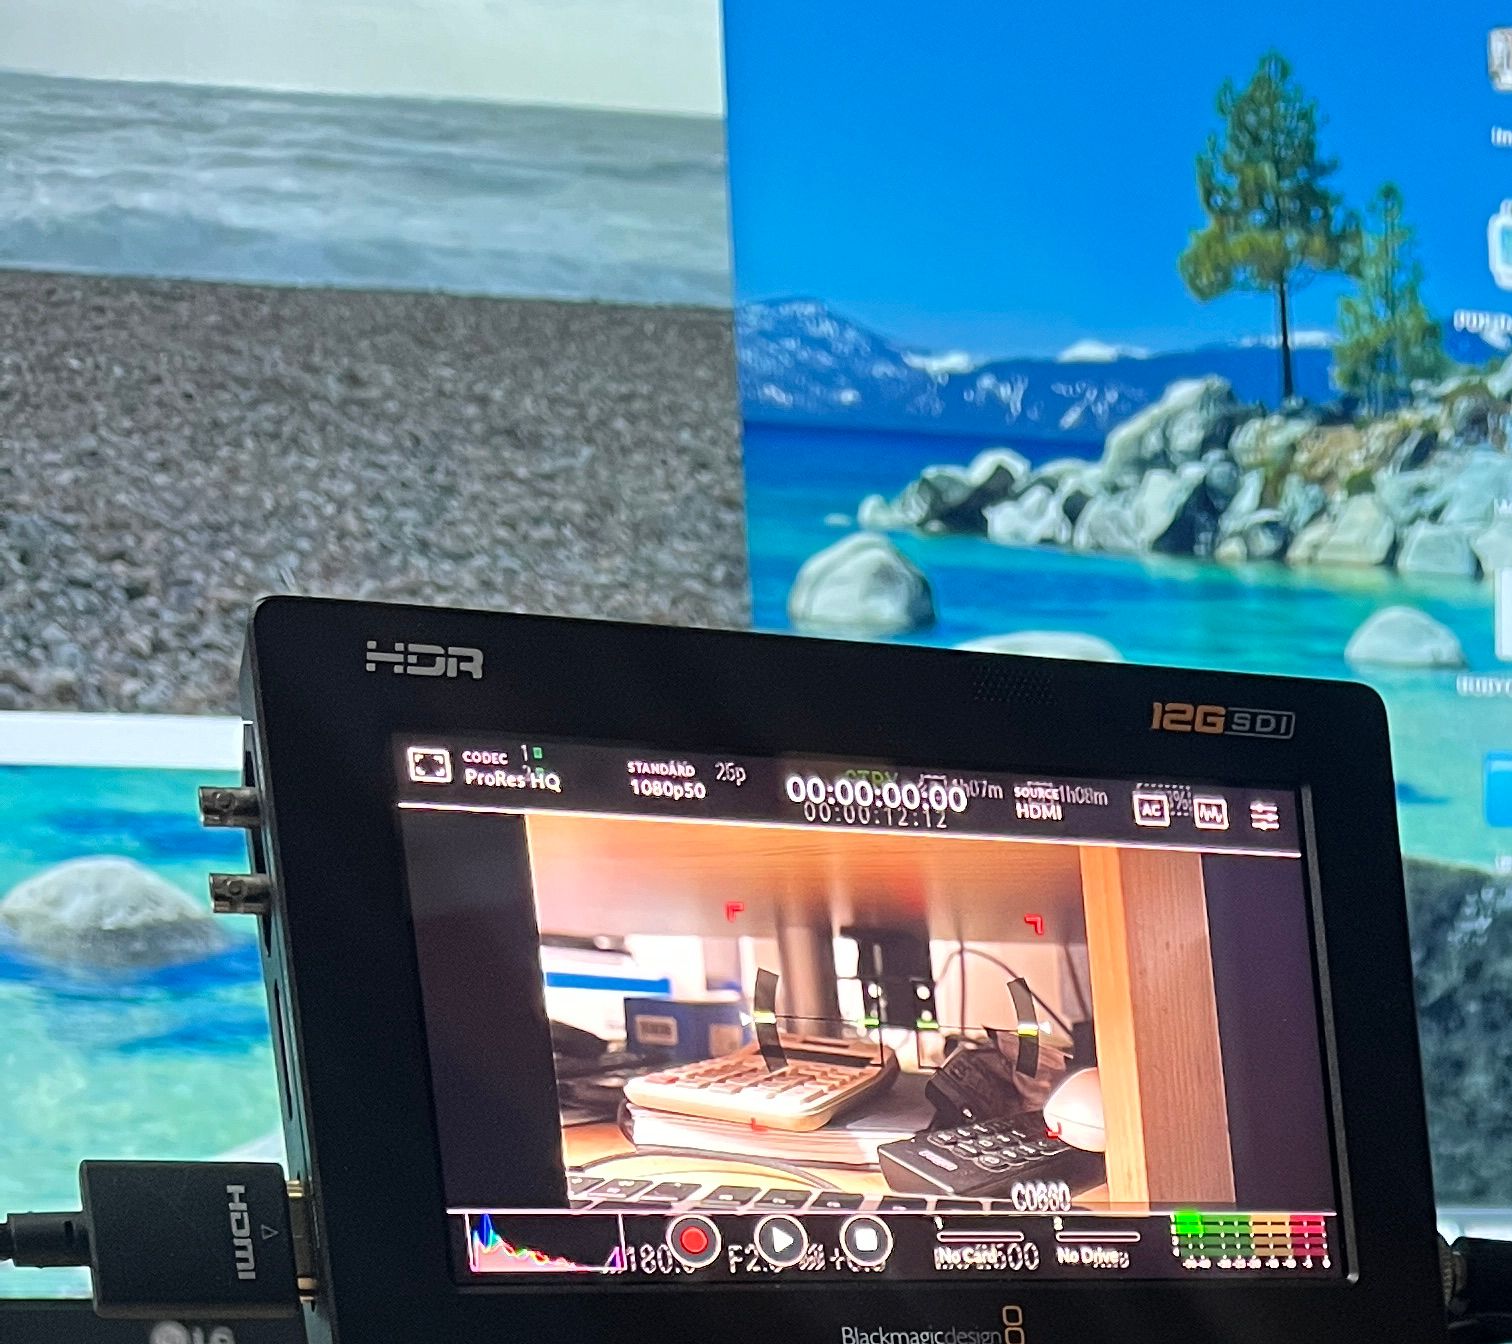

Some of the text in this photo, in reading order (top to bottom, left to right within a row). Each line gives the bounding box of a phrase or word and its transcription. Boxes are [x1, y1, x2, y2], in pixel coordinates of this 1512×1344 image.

[366, 640, 484, 679] HDR
[1152, 702, 1289, 734] 12G SDI
[462, 750, 508, 765] CODEC
[465, 768, 562, 793] ProRes HQ
[627, 761, 696, 778] STANDARD
[631, 778, 706, 800] 1080p50
[787, 775, 968, 813] 00:00:00:00
[1013, 786, 1060, 801] SOURCE
[1015, 803, 1064, 821] HDMI
[226, 1184, 257, 1280] HDMI
